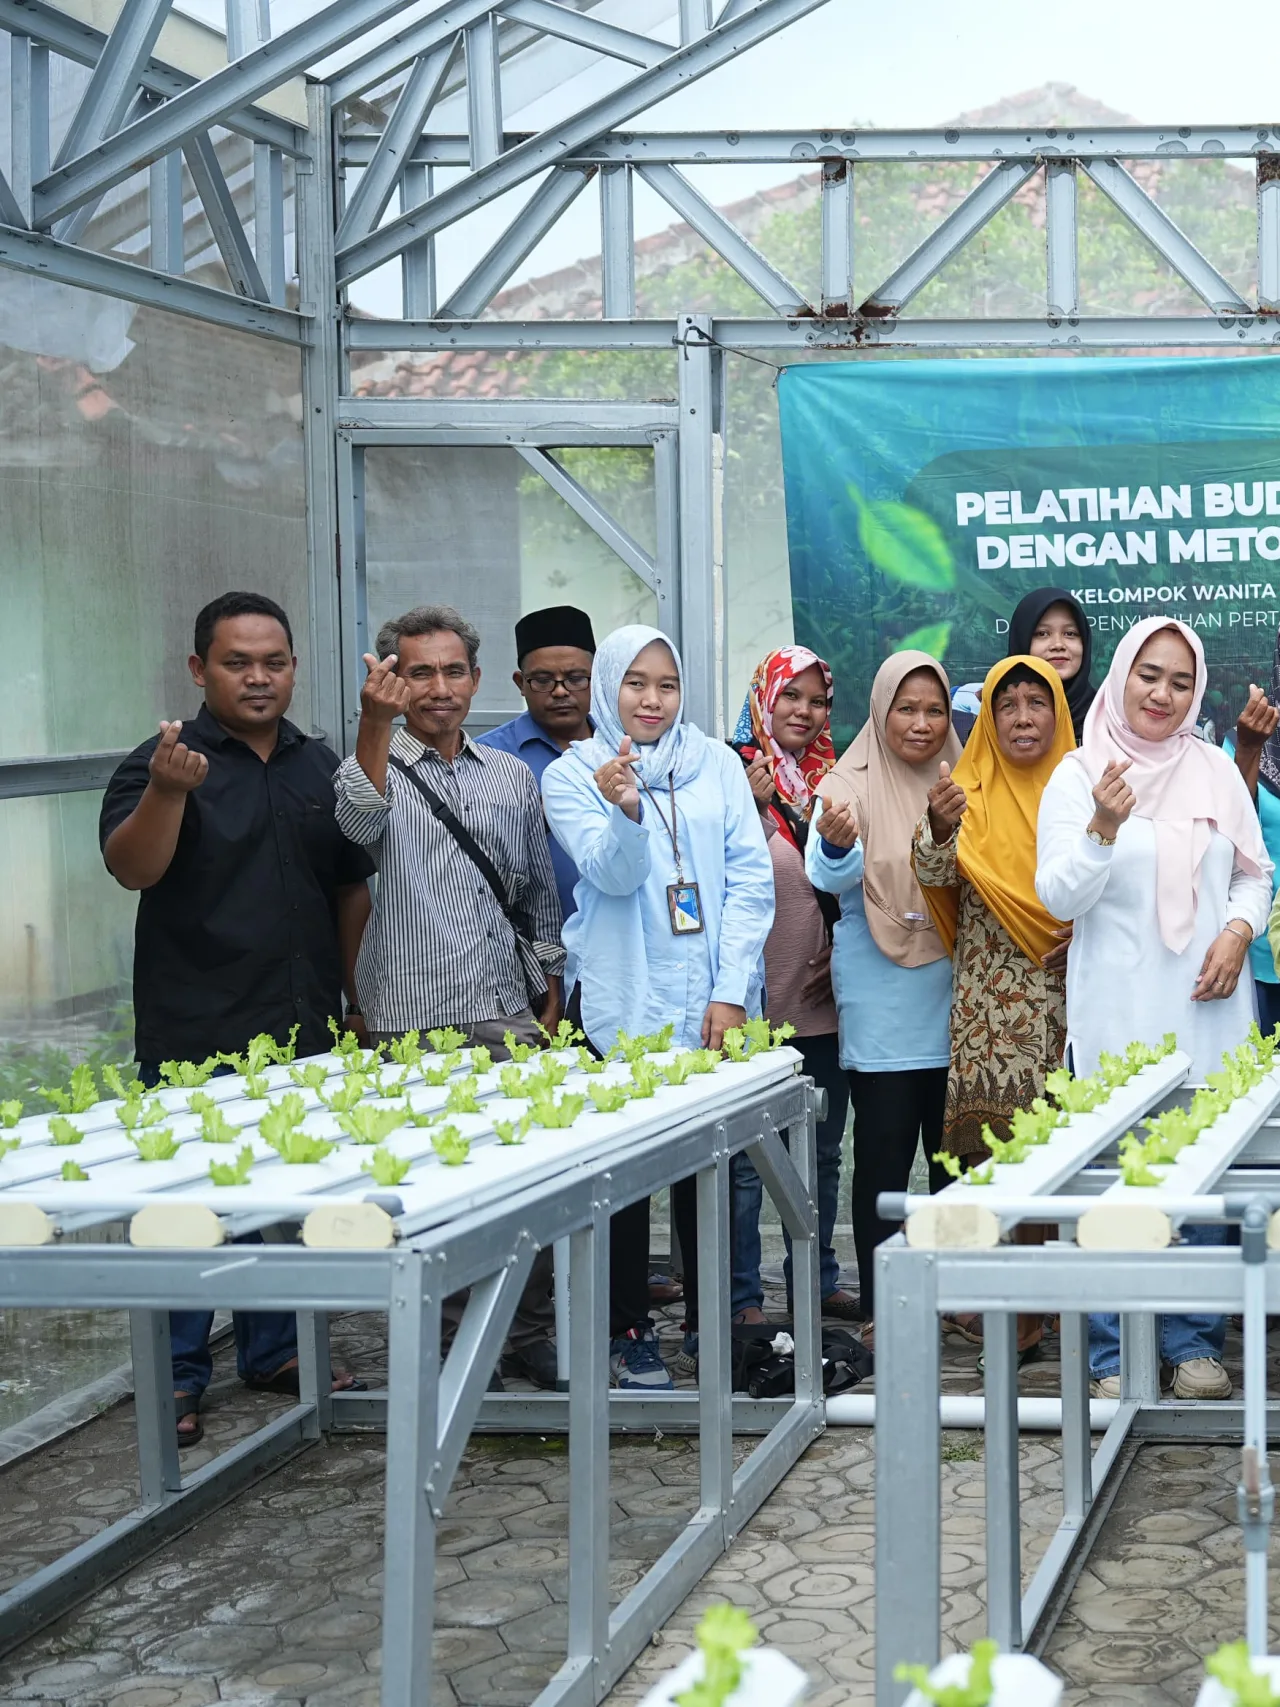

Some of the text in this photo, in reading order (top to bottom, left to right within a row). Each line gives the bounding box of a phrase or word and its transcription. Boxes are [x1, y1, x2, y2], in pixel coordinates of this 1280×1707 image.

[955, 484, 1192, 526] PELATIHAN
[976, 530, 1157, 569] DENGAN
[1070, 586, 1188, 604] KELOMPOK
[1192, 583, 1277, 600] WANITA
[1086, 612, 1222, 631] PENYHAN
